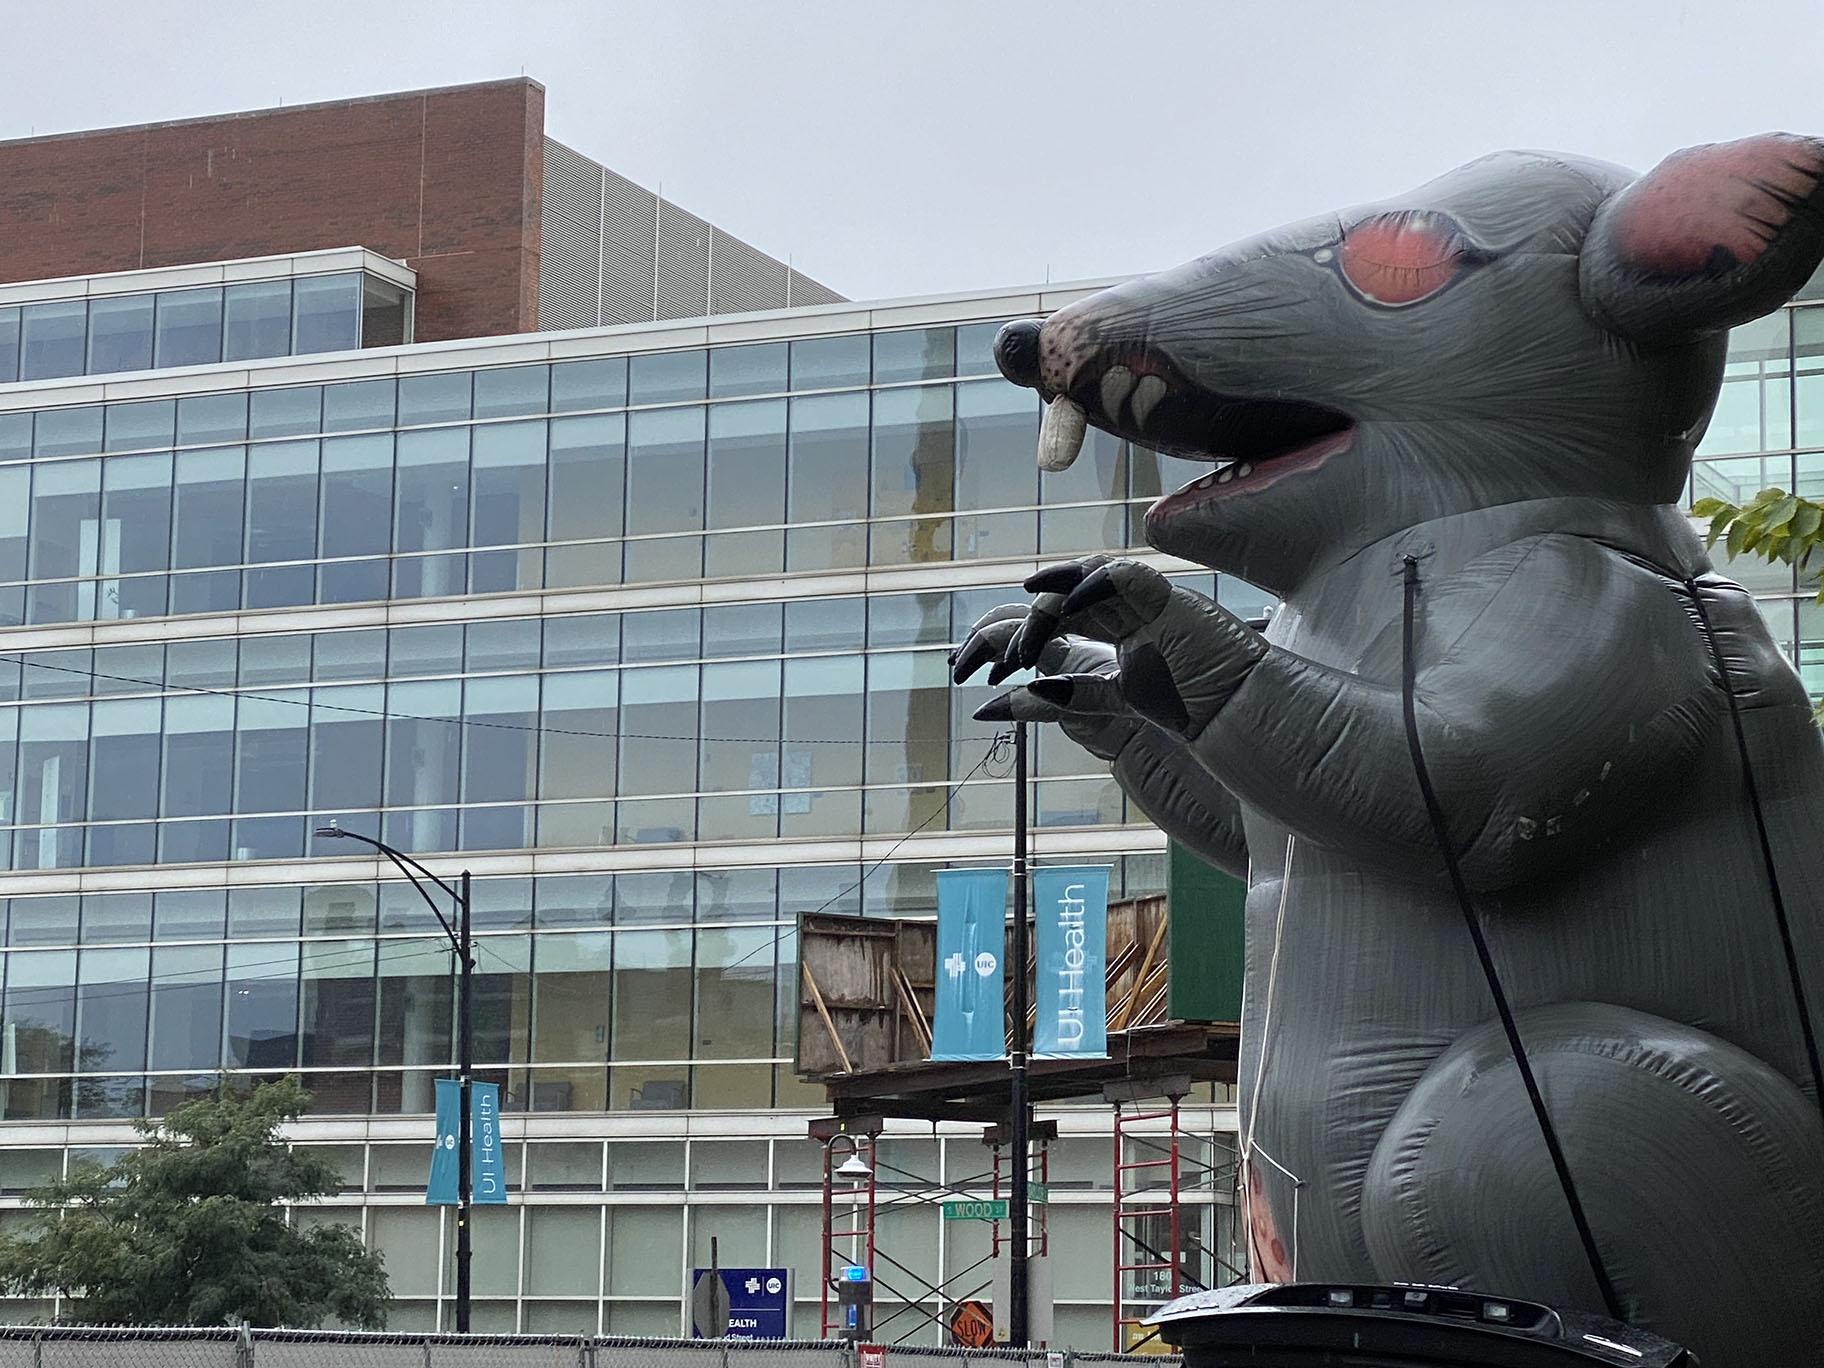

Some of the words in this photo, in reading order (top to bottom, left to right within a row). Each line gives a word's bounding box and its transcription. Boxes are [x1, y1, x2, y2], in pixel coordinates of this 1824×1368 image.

[1057, 884, 1085, 992] Health
[976, 960, 995, 969] UIC
[1057, 1009, 1084, 1043] UI
[480, 1094, 494, 1163] Health
[482, 1172, 496, 1194] UI
[954, 1202, 993, 1217] WOOD
